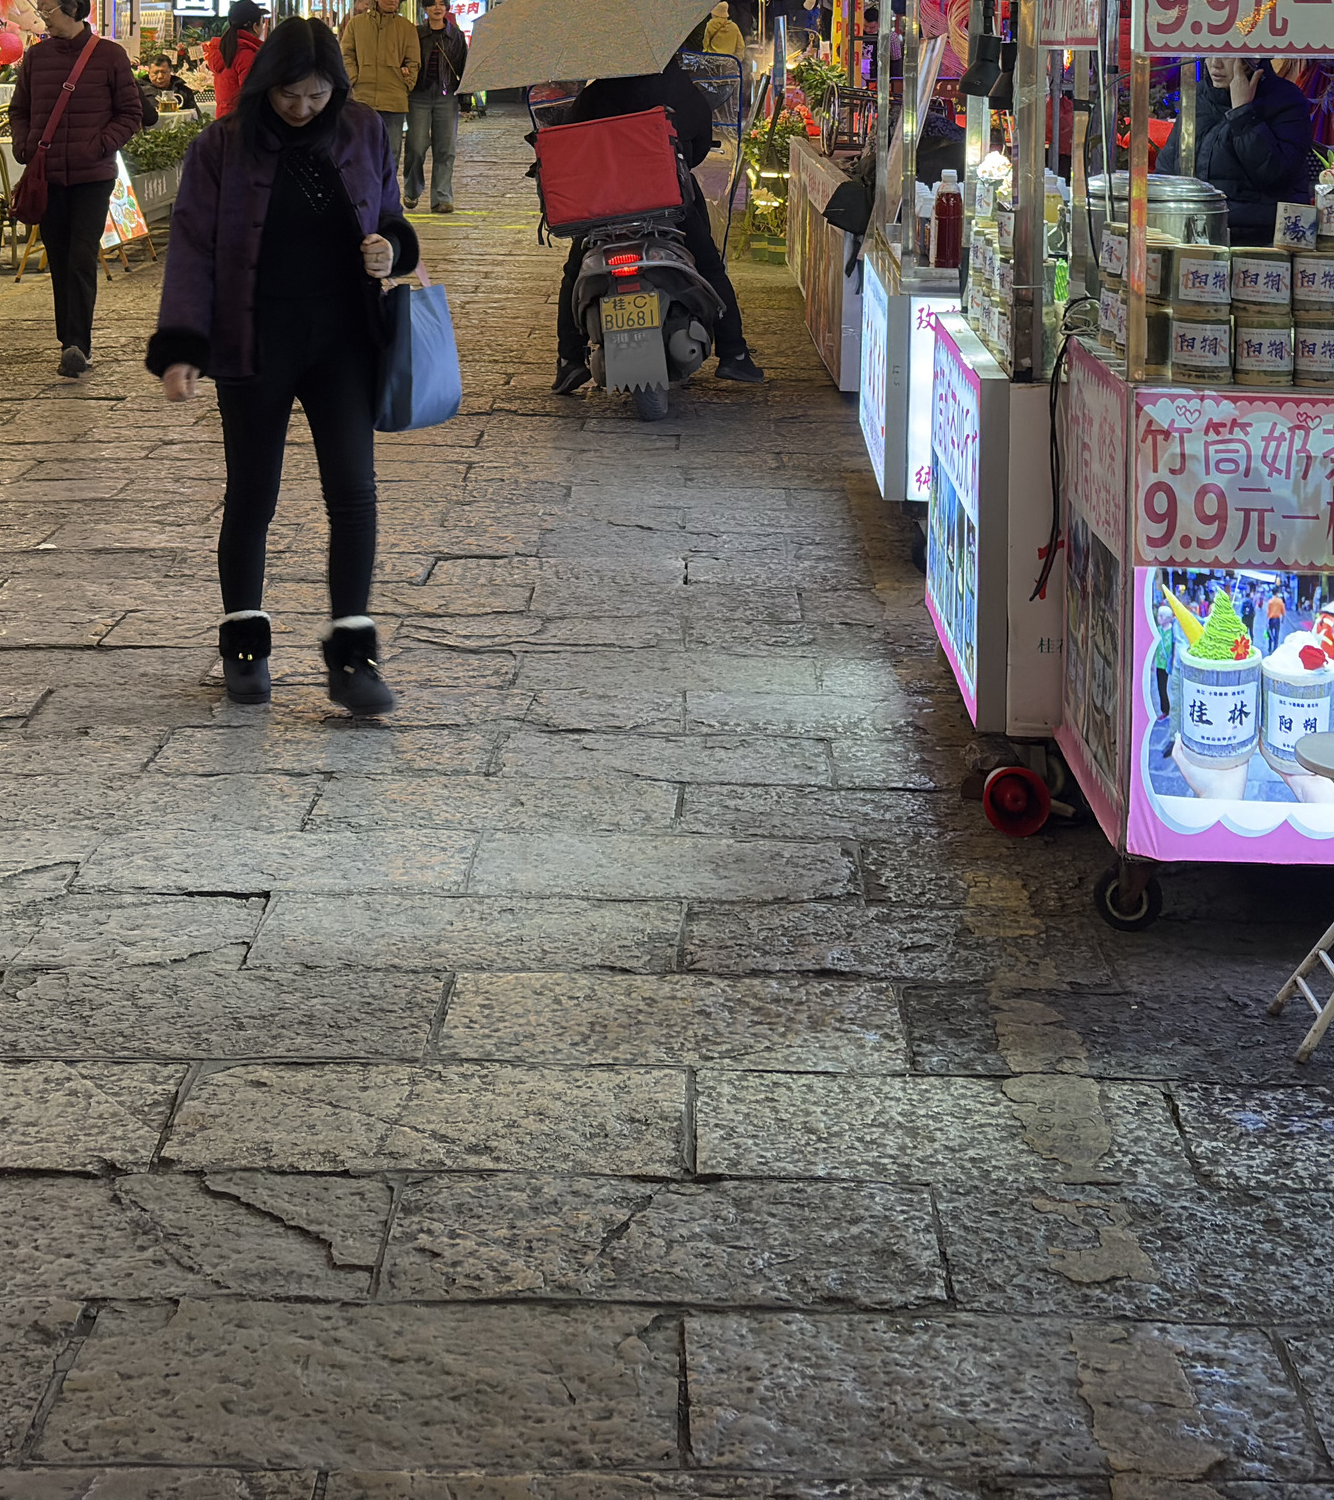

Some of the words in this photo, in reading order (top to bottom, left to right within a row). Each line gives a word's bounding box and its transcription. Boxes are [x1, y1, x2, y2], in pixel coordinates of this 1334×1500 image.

[449, 1, 480, 16] 羊肉
[1241, 269, 1282, 293] 阳朔
[611, 295, 648, 312] 桂·C
[604, 309, 654, 331] BU681
[1179, 333, 1218, 356] 阳朔
[1244, 339, 1284, 362] 阳朔
[1189, 698, 1251, 727] 桂林
[1278, 714, 1318, 735] 阳朔
